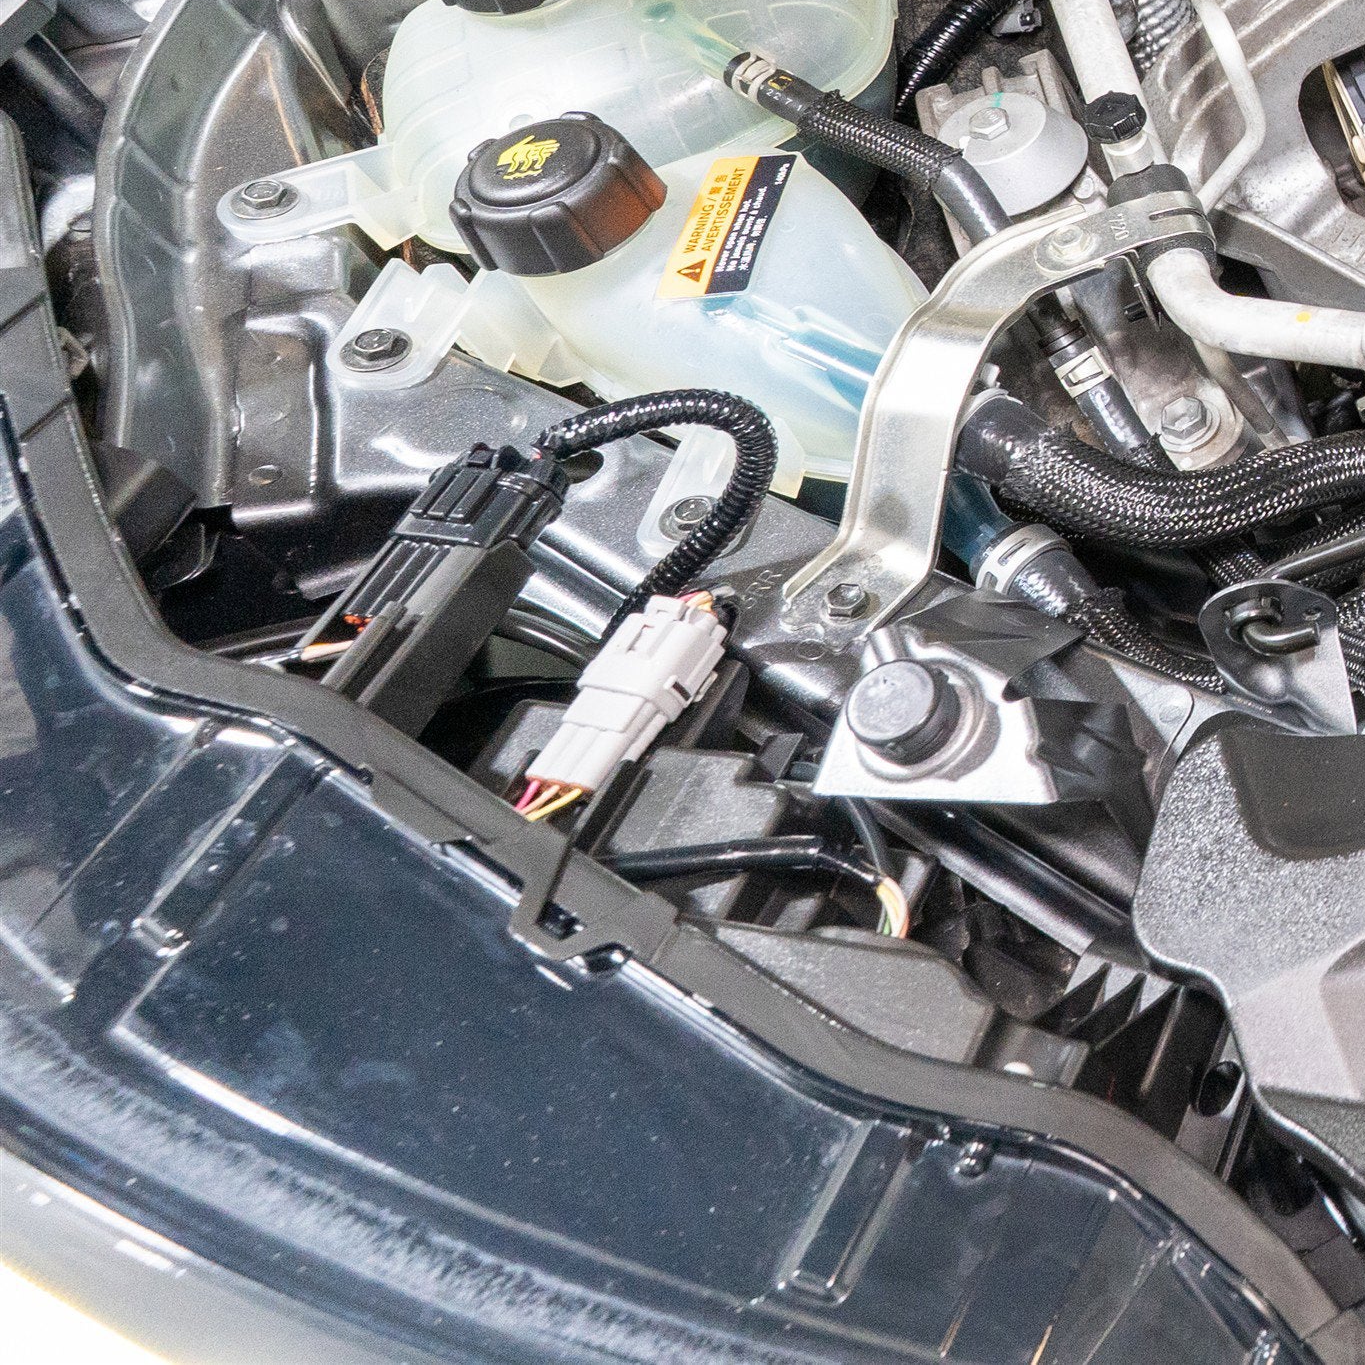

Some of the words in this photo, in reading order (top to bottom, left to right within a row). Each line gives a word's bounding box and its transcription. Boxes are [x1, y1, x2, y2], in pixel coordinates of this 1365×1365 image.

[683, 203, 715, 253] WARNING
[701, 167, 746, 253] AVERTISSEMENT
[714, 251, 732, 272] Never
[725, 233, 739, 248] open
[732, 213, 747, 230] when
